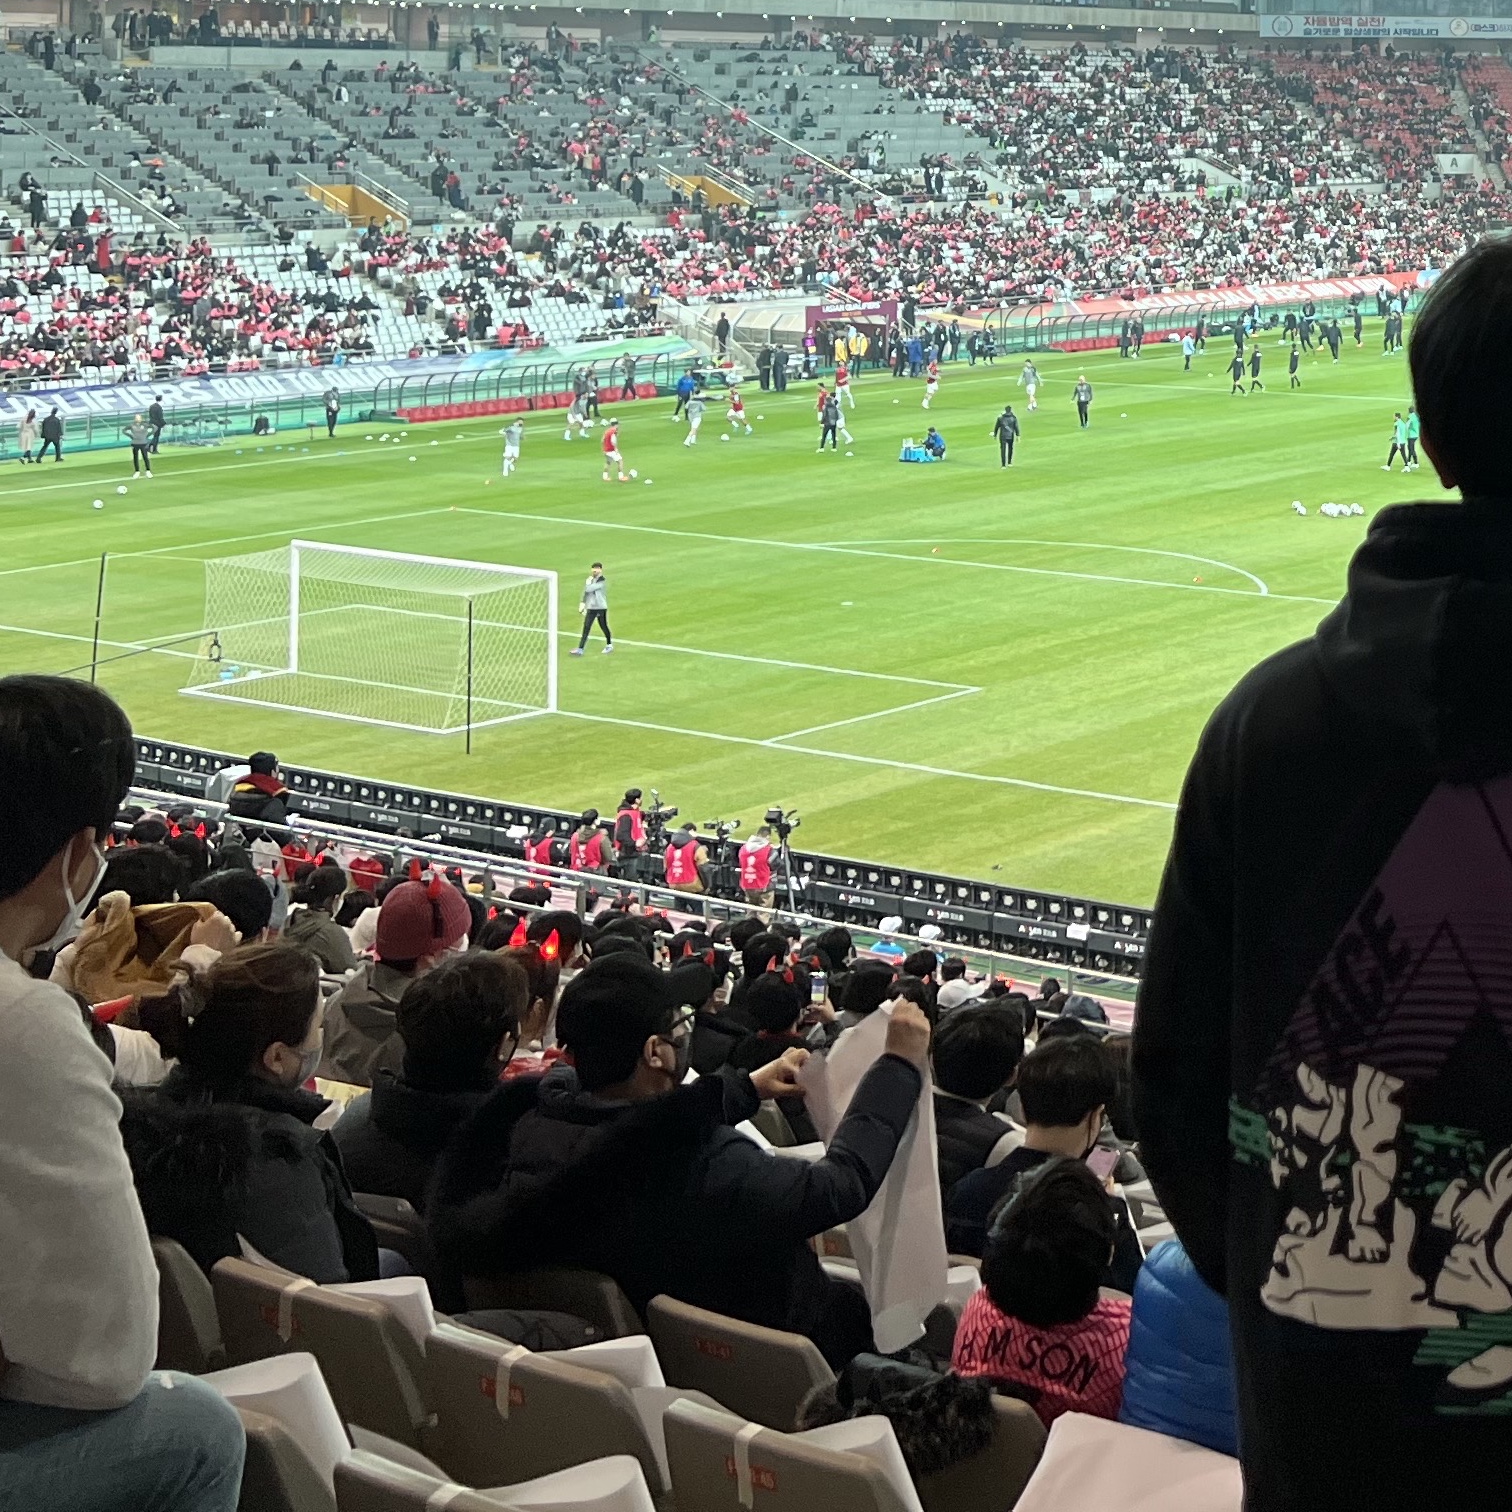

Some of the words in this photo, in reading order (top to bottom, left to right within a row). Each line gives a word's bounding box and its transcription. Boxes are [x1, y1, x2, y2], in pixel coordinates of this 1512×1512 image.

[1357, 16, 1386, 27] 실천!
[1449, 157, 1459, 168] A
[210, 375, 287, 400] ROAD
[283, 371, 319, 391] TO
[323, 365, 400, 389] QATAR
[983, 1326, 1012, 1366] M
[1019, 1335, 1100, 1395] SON
